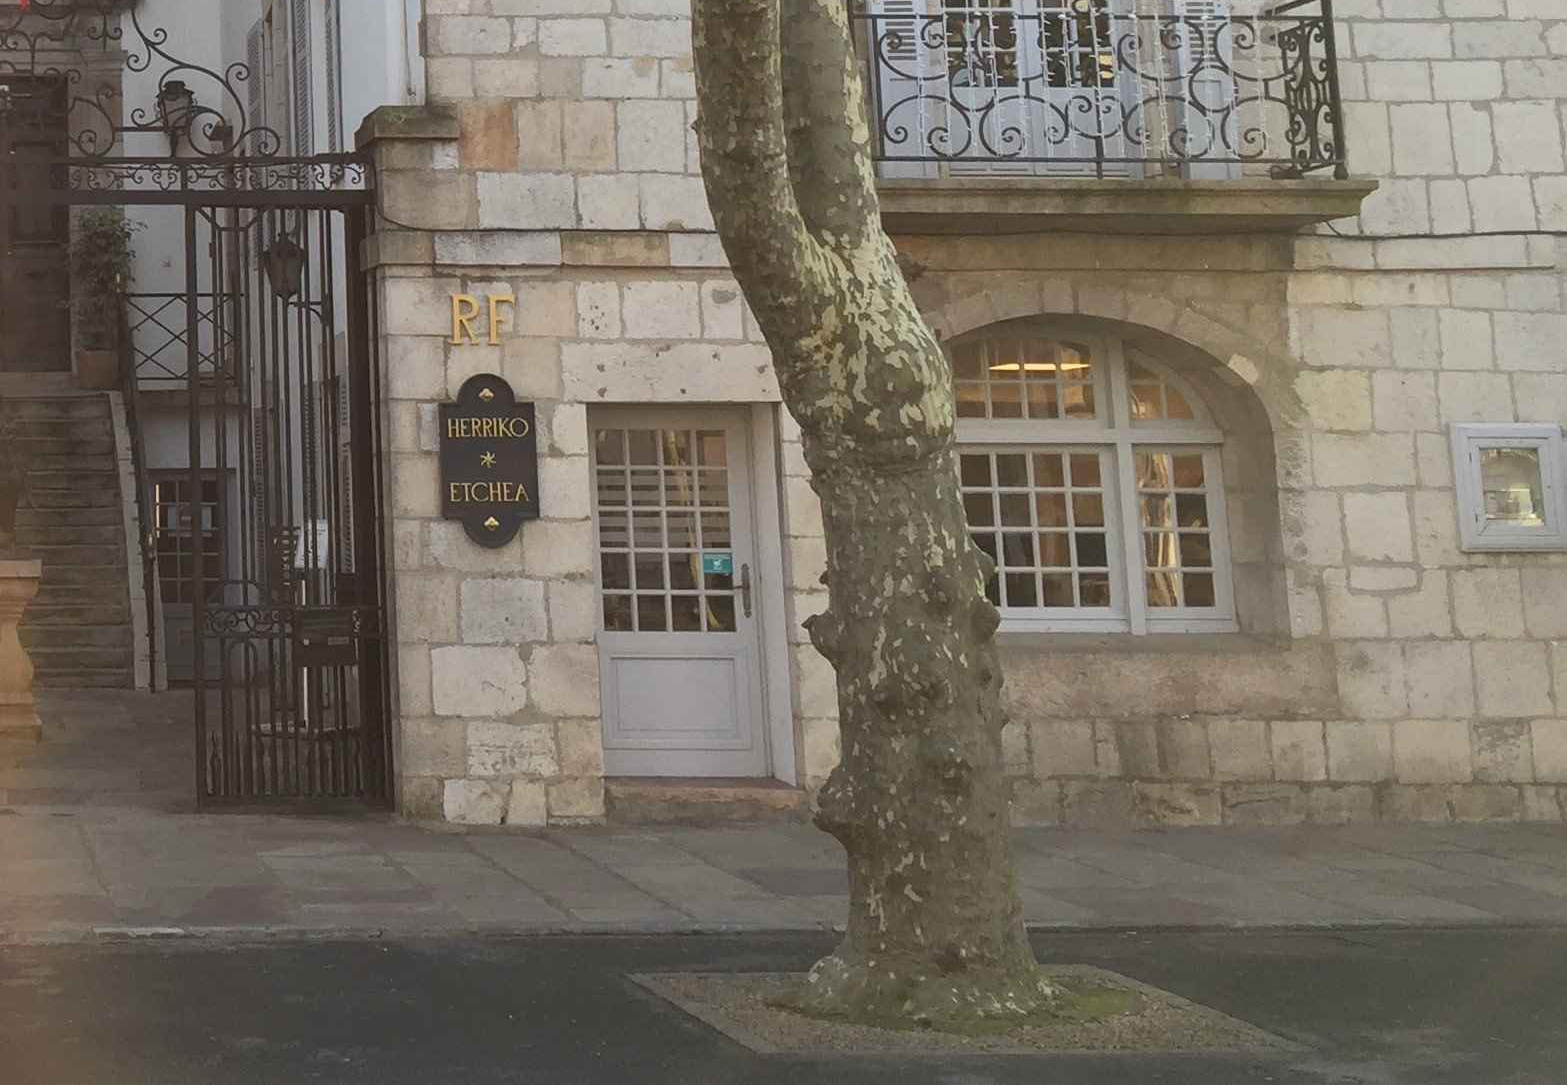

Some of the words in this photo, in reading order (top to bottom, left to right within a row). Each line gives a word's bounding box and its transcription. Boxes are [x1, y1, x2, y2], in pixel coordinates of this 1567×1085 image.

[449, 293, 515, 345] RF
[447, 417, 529, 438] HERRIKO
[449, 481, 530, 502] ETCHEA
